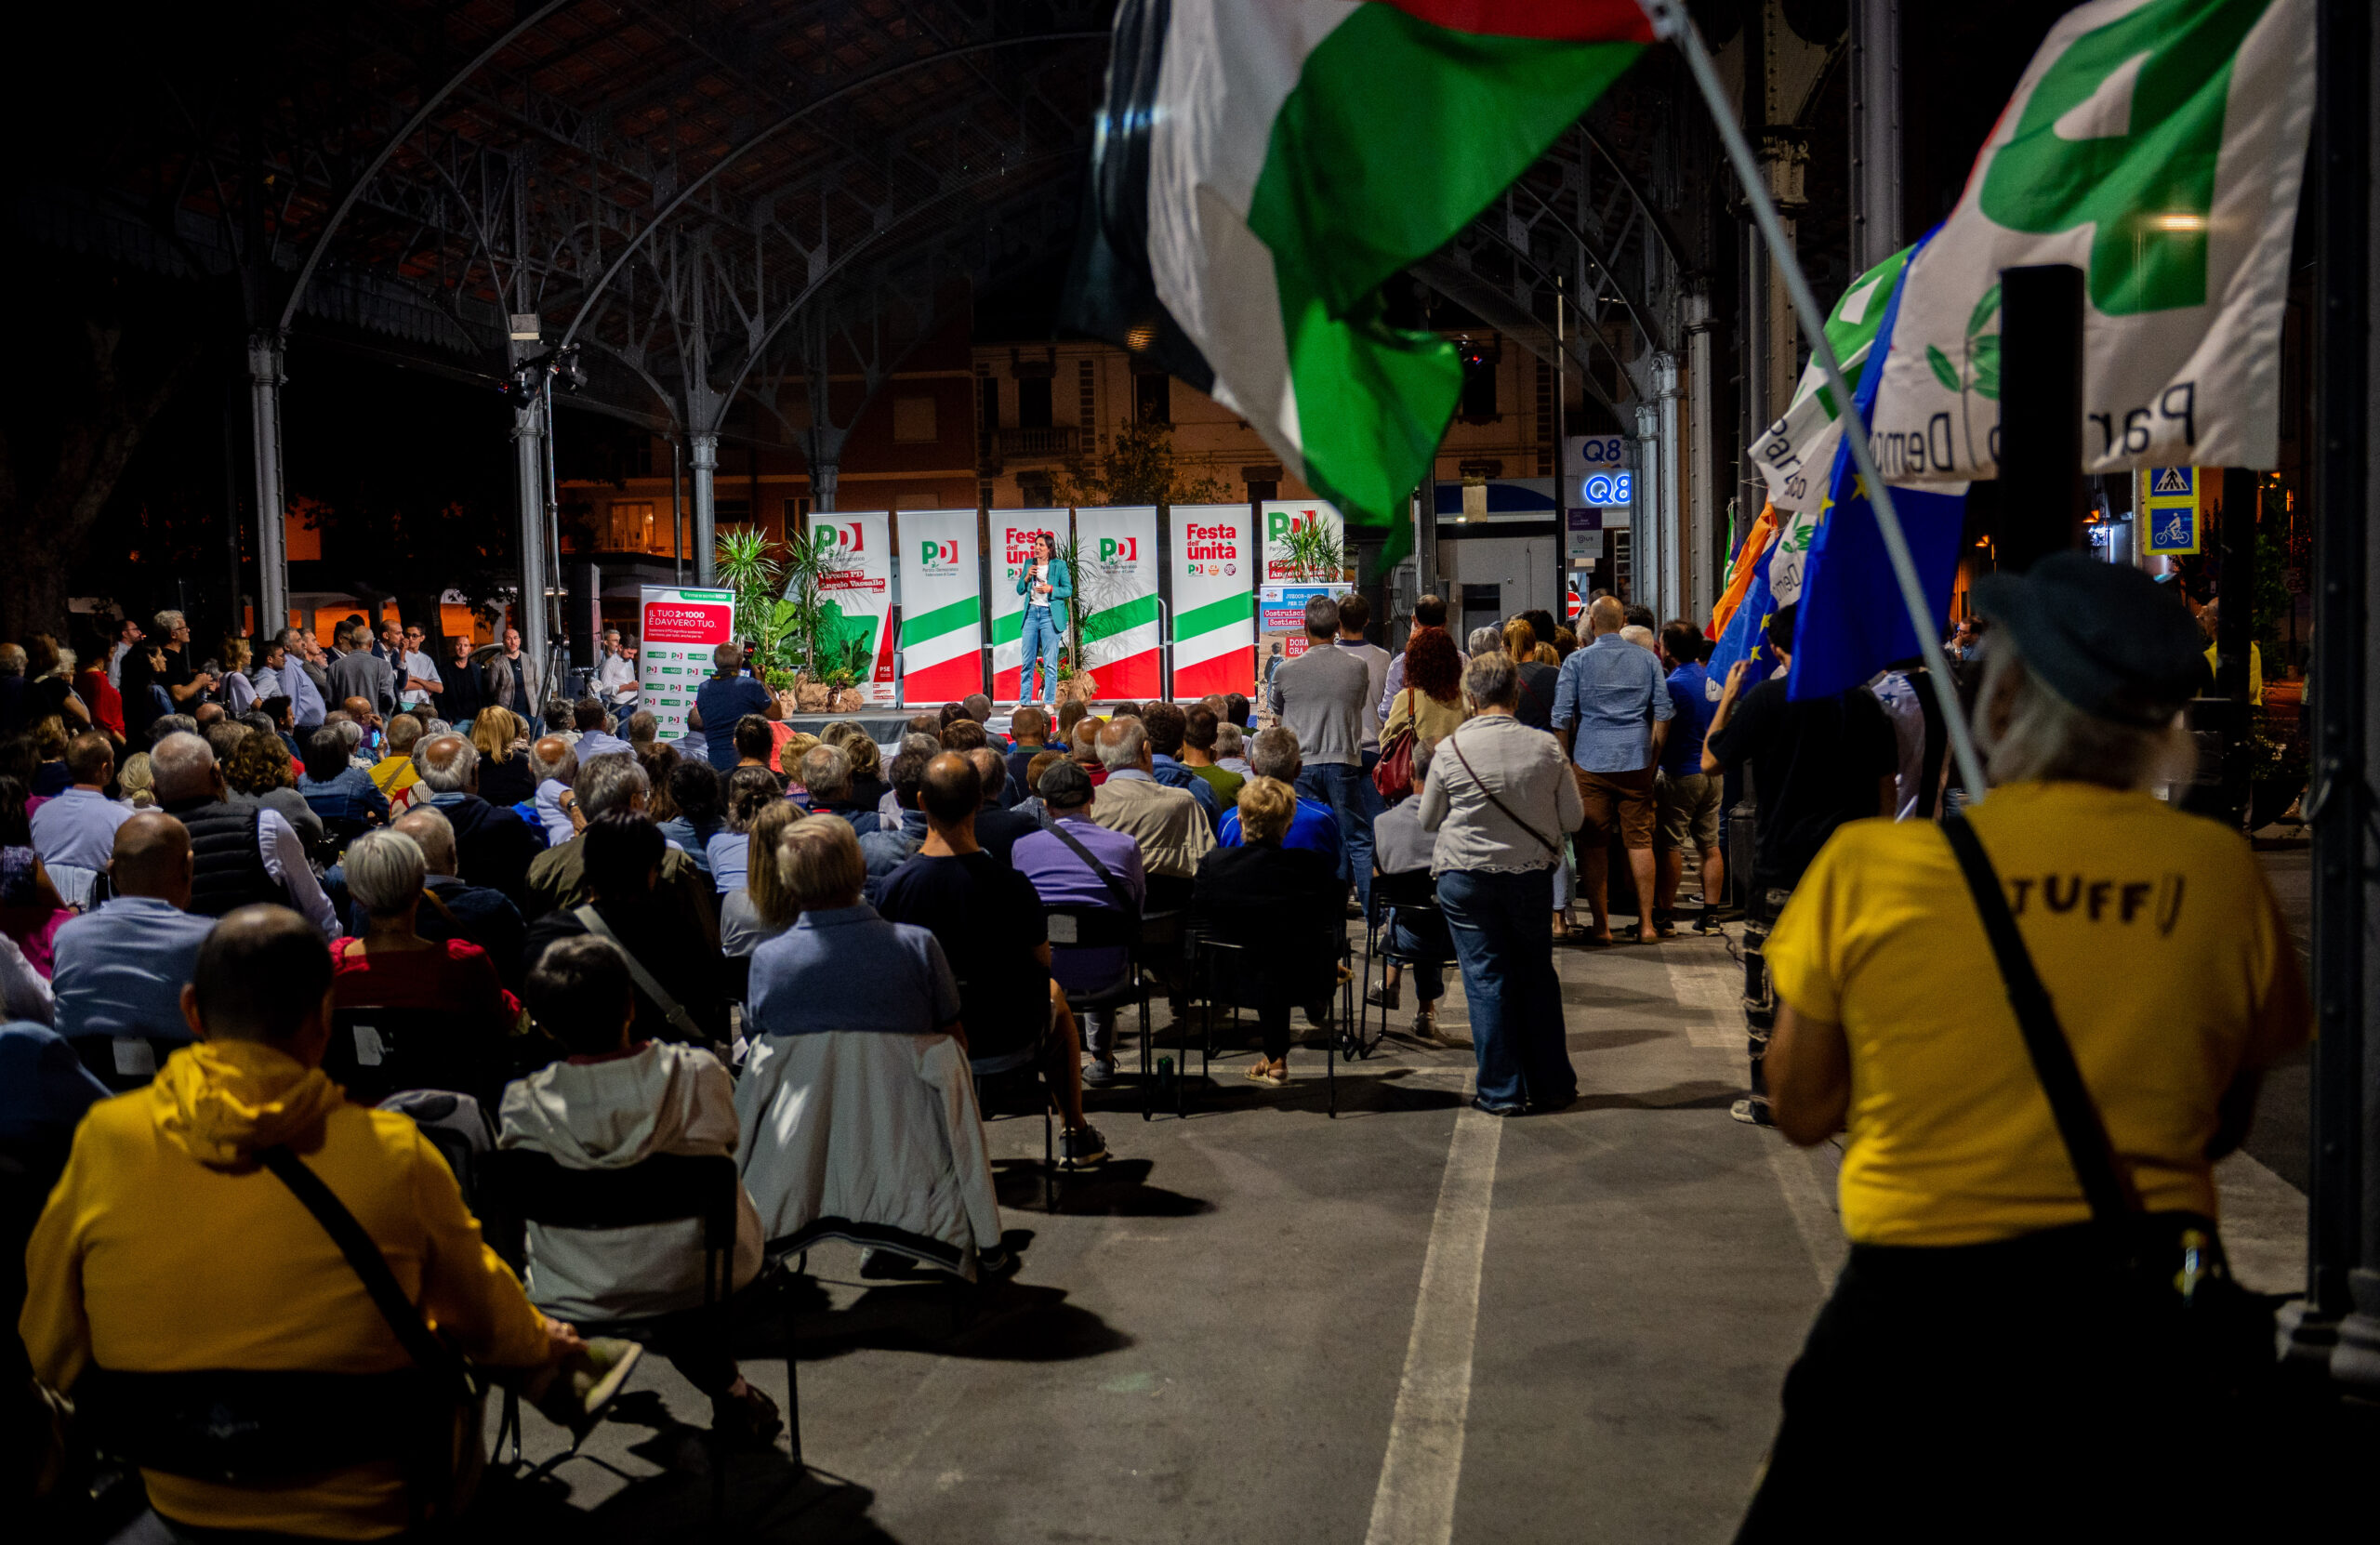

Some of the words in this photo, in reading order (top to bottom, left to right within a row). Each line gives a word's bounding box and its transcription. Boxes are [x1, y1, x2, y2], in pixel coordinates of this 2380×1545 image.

[1582, 439, 1621, 462] Q8
[1584, 475, 1632, 505] Q8
[815, 522, 864, 554] PD
[1187, 523, 1236, 539] Festa
[922, 540, 959, 564] PD
[1006, 546, 1035, 564] uni
[1100, 537, 1137, 561] PD
[1187, 541, 1236, 560] unità
[1188, 563, 1204, 574] PD
[850, 578, 883, 587] Vassallo
[649, 616, 654, 626] È
[654, 618, 695, 627] DAVVERO
[697, 620, 717, 628] TUO.
[2008, 875, 2153, 923] TUFF
